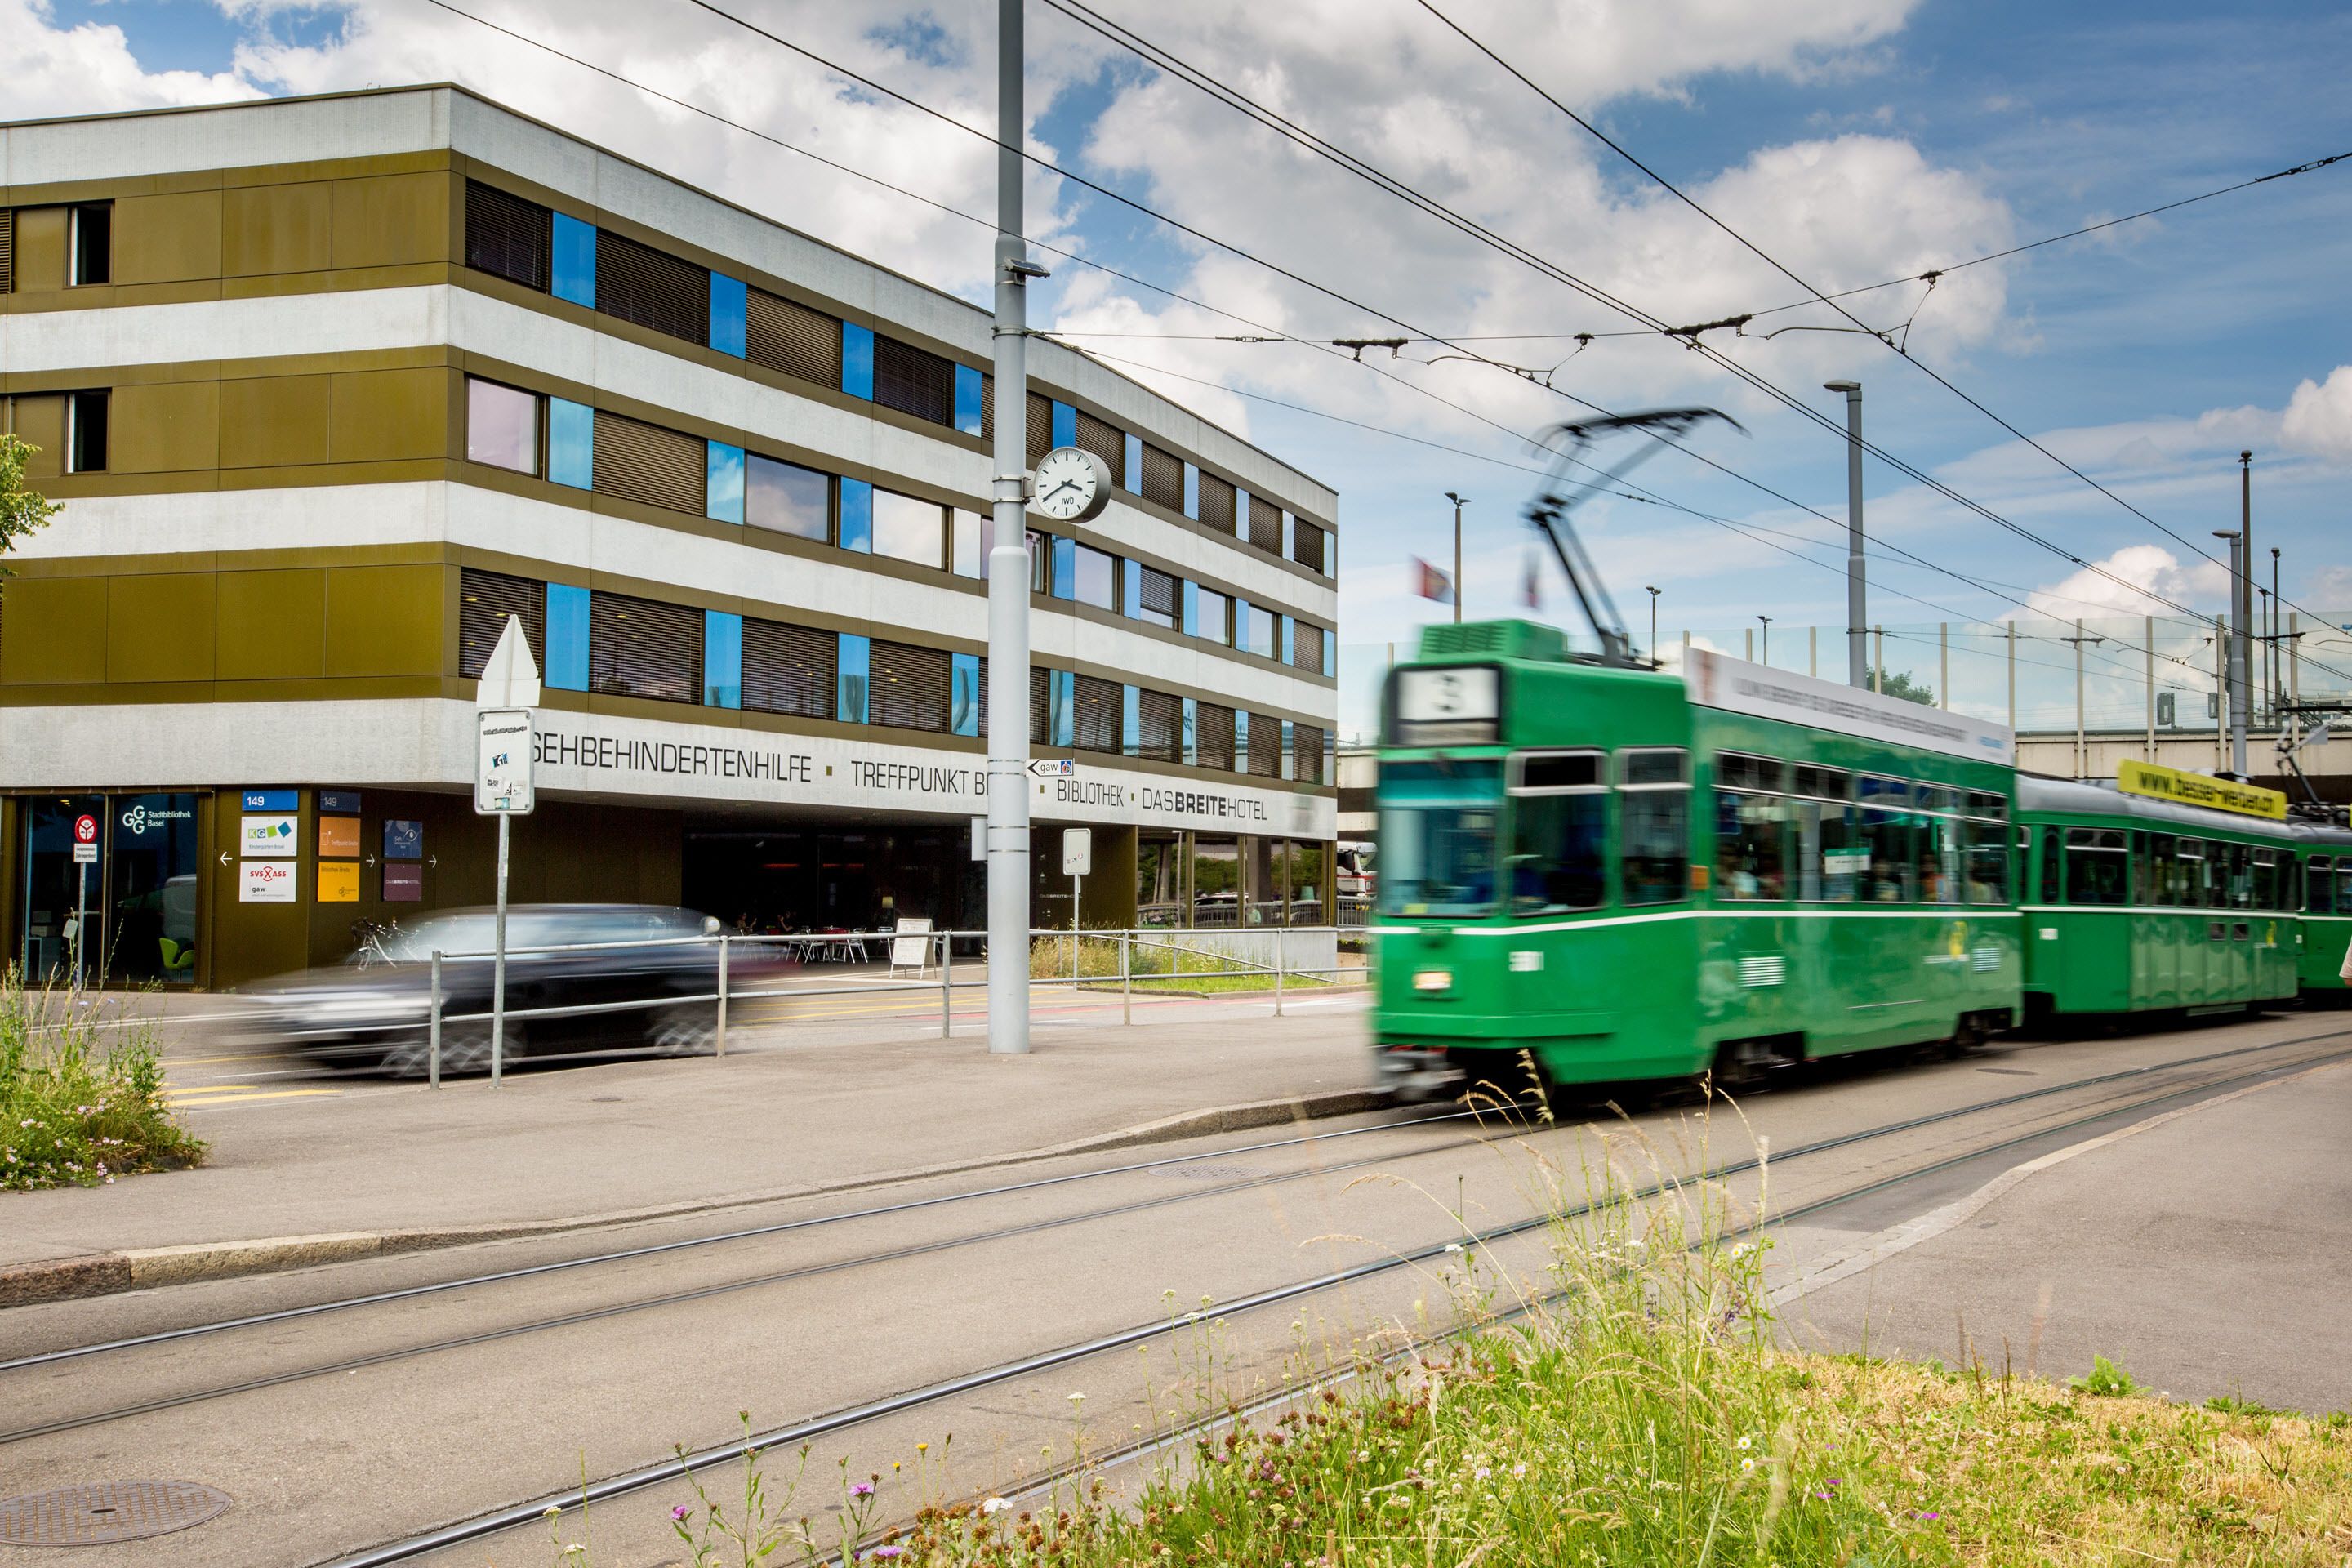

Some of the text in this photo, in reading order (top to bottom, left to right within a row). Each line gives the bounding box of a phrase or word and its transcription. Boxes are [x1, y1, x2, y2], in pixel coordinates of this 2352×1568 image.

[1040, 764, 1058, 773] gaw
[851, 760, 969, 795] TREFFPUNKT
[1057, 778, 1125, 808] BIBLIOTHEK
[247, 796, 265, 806] 149
[324, 797, 337, 807] 149
[1143, 787, 1267, 821] DASBREITEHOTEL
[147, 810, 192, 818] Stadtbibliothek
